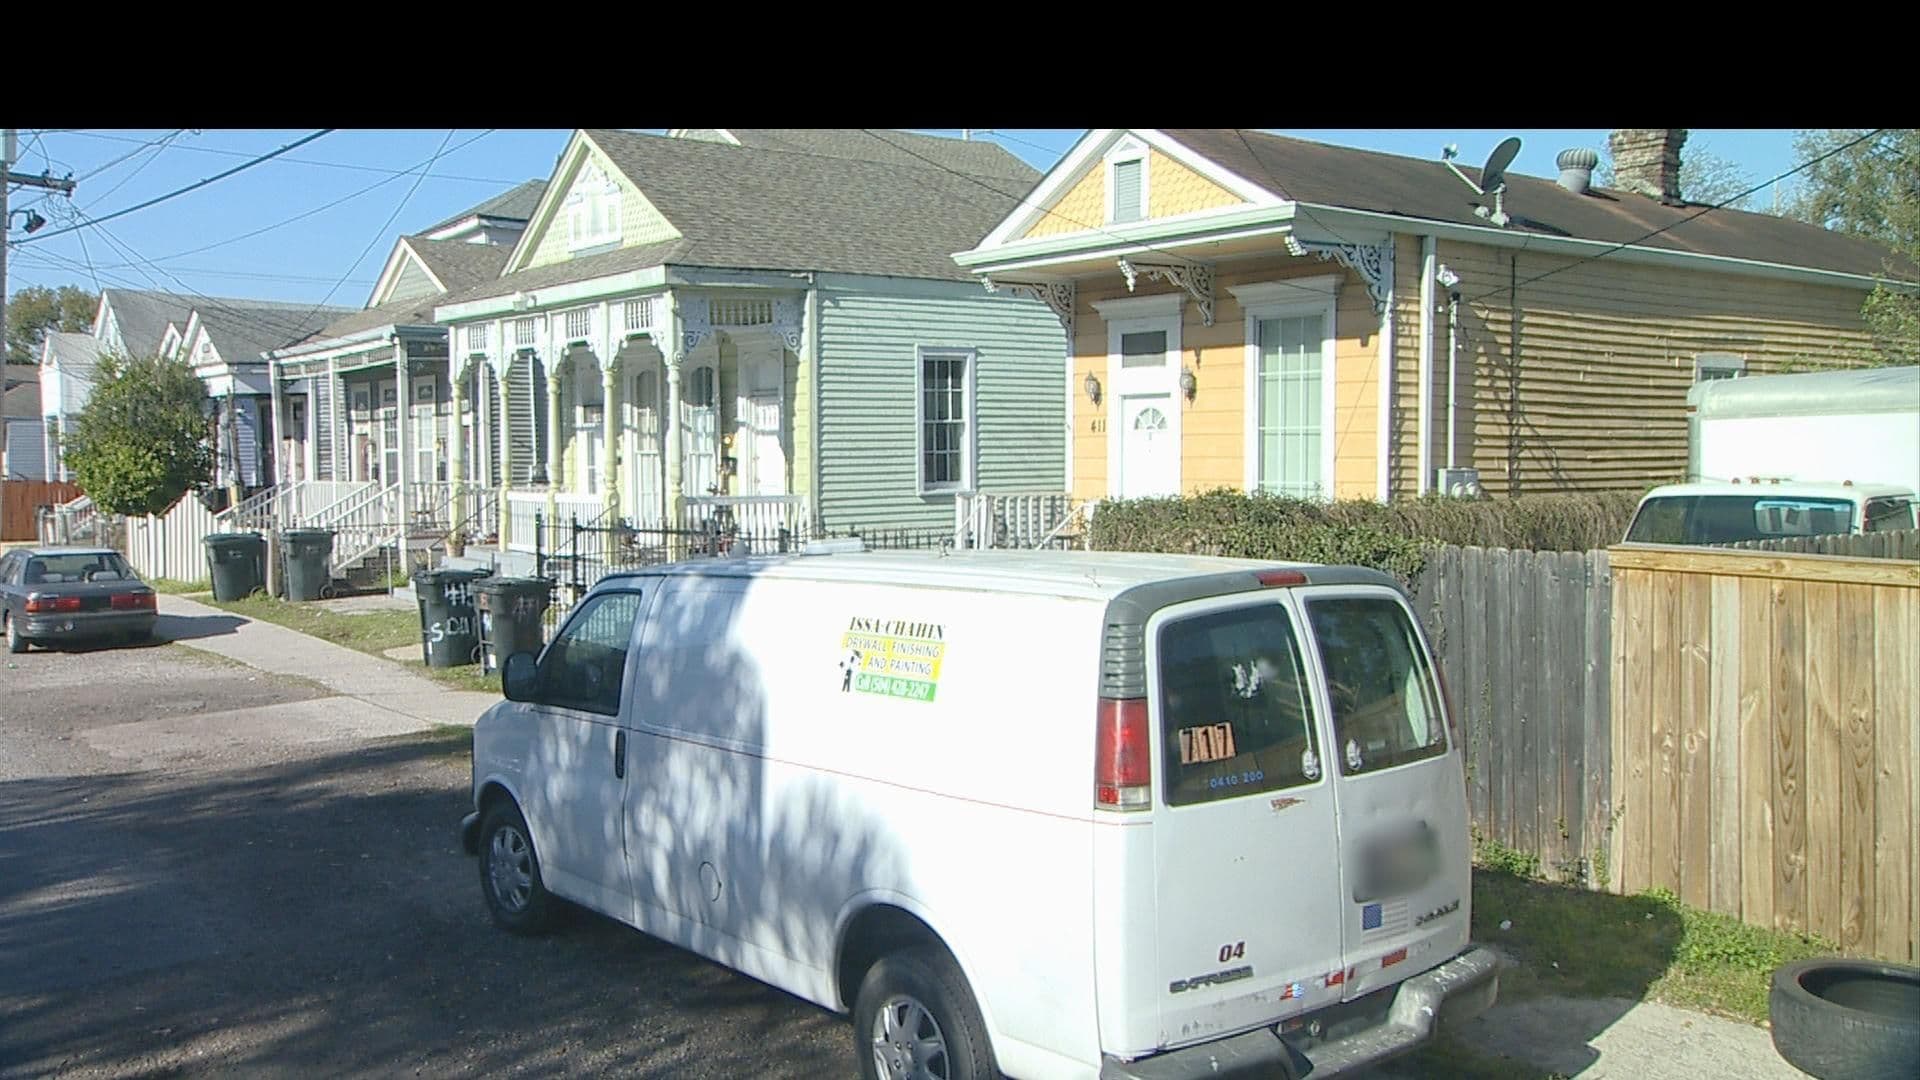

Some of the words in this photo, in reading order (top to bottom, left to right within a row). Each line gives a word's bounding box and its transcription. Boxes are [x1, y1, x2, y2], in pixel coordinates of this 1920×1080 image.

[849, 617, 880, 633] ISSA
[846, 636, 886, 652] DRYWALL
[891, 640, 940, 658] FINISHING
[867, 656, 887, 670] AND
[890, 660, 932, 675] PAINTING
[1182, 725, 1228, 761] 717
[1218, 941, 1246, 963] 04
